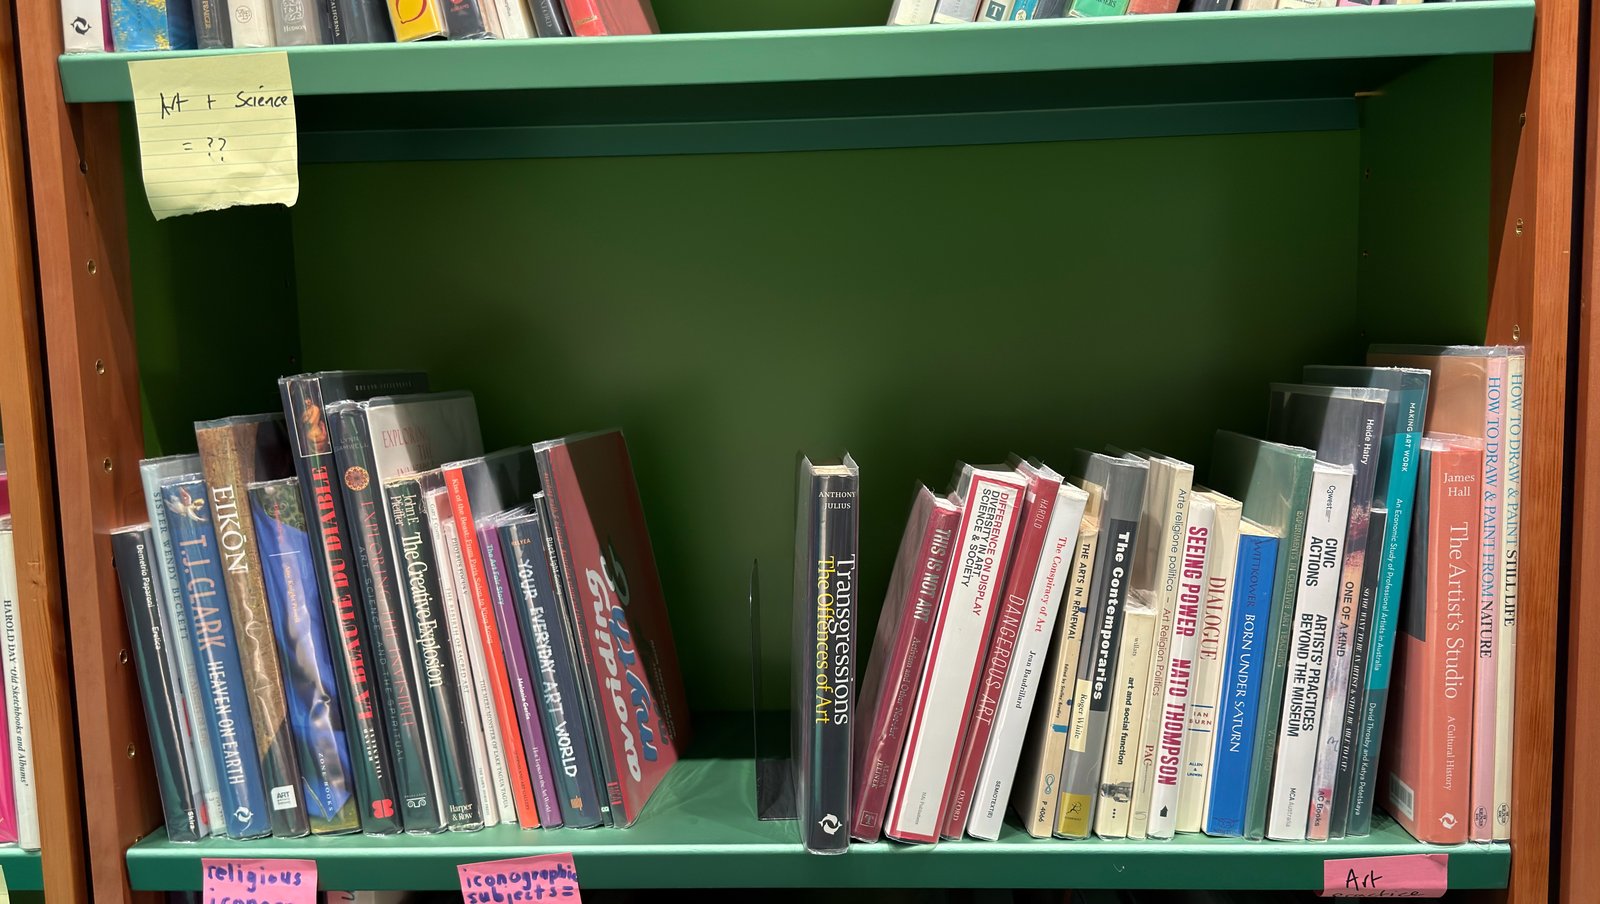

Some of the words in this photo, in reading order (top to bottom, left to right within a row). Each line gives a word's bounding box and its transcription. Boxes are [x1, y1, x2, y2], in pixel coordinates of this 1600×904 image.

[160, 93, 189, 120] Art
[207, 95, 217, 110] +
[235, 85, 288, 108] Science
[182, 142, 192, 151] =
[207, 137, 227, 162] ??
[1487, 376, 1500, 413] HOW
[1510, 373, 1522, 411] HOW
[1362, 418, 1376, 442] Heide
[1405, 402, 1416, 432] MAKING
[1486, 417, 1498, 438] TO
[1509, 415, 1521, 435] TO
[1359, 442, 1372, 464] Hatry
[1404, 434, 1412, 447] ART
[1400, 449, 1410, 472] WORK
[1485, 442, 1498, 486] DRAW
[1507, 439, 1520, 484] DRAW
[1444, 472, 1475, 484] James
[1448, 486, 1470, 496] Hall
[1507, 487, 1518, 499] &
[310, 465, 342, 551] DIABLE
[824, 502, 851, 510] JULIUS
[973, 487, 991, 533] SCIENCE
[1176, 488, 1187, 509] Arte
[1395, 498, 1402, 508] An
[1484, 490, 1496, 502] &
[980, 489, 1000, 542] DIVERSITY
[986, 492, 1009, 556] DIFFERENCE
[1033, 498, 1048, 529] HAROLD
[1391, 509, 1401, 541] Economic
[1483, 505, 1496, 550] PAINT
[1505, 502, 1518, 547] PAINT
[401, 530, 424, 560] The
[929, 525, 952, 556] THIS
[971, 533, 980, 541] &
[1055, 535, 1067, 554] The
[1114, 530, 1129, 562] The
[1168, 510, 1184, 552] religione
[1448, 520, 1469, 559] The
[179, 534, 211, 574] T.J.
[358, 545, 368, 568] ART
[925, 556, 943, 572] IS
[977, 543, 987, 555] IN
[1080, 542, 1090, 558] THE
[1181, 525, 1210, 580] SEEING
[1306, 536, 1324, 587] ACTIONS
[1323, 538, 1338, 568] CIVIC
[1387, 543, 1397, 562] Study
[153, 491, 168, 534] SISTER
[162, 539, 177, 580] WENDY
[171, 587, 189, 641] BECKETT
[328, 554, 349, 588] DU
[516, 558, 538, 600] YOUR
[817, 555, 835, 589] The
[960, 543, 978, 587] SOCIETY
[981, 556, 993, 574] ON
[1040, 554, 1061, 605] Conspiracy
[1076, 562, 1086, 583] ARTS
[1163, 555, 1178, 591] politica
[1246, 538, 1262, 607] WITTKOWER
[1481, 552, 1494, 597] FROM
[1504, 549, 1517, 592] STILL
[406, 560, 436, 620] Creative
[444, 587, 452, 600] THE
[919, 571, 940, 597] NOT
[971, 573, 989, 615] DISPLAY
[1074, 586, 1082, 596] IN
[1342, 580, 1355, 603] ONE
[1381, 571, 1393, 611] Professional
[1445, 562, 1467, 631] Artist's
[186, 575, 225, 652] CLARK
[364, 577, 380, 630] SCIENCE
[912, 597, 933, 623] ART
[1039, 606, 1048, 615] of
[1161, 607, 1172, 622] Art
[1174, 582, 1202, 637] POWER
[1198, 575, 1227, 661] DIALOGUE
[1340, 605, 1351, 620] OF
[1503, 594, 1516, 626] LIFE
[447, 604, 458, 635] REBIRTH
[815, 592, 835, 669] Offences
[1034, 616, 1045, 633] Art
[1067, 599, 1080, 640] RENEWAL
[1091, 565, 1124, 700] Contemporaries
[1241, 613, 1255, 650] BORN
[1298, 612, 1313, 658] BEYOND
[1339, 622, 1348, 631] A
[1378, 612, 1387, 634] Artists
[1479, 599, 1493, 657] NATURE
[376, 640, 386, 665] AND
[414, 618, 447, 688] Explosion
[453, 637, 461, 647] OF
[528, 605, 556, 675] EVERYDAY
[831, 553, 856, 726] Transgressions
[988, 594, 1024, 689] DANGEROUS
[1154, 624, 1170, 662] Religion
[1310, 613, 1328, 665] ARTISTS'
[1335, 632, 1348, 657] KIND
[1377, 634, 1384, 642] in
[456, 649, 466, 678] SACRED
[1026, 649, 1035, 667] Jean
[1373, 642, 1383, 670] Australia
[1442, 637, 1465, 699] Studio
[382, 672, 391, 692] THE
[461, 679, 469, 693] ART
[816, 673, 832, 692] of
[1152, 664, 1164, 696] Politics
[1167, 657, 1193, 698] NATO
[1235, 652, 1251, 697] UNDER
[1294, 660, 1308, 684] THE
[206, 660, 232, 717] HEAVEN
[541, 679, 563, 716] ART
[1015, 668, 1031, 709] Baudrillard
[1077, 693, 1087, 714] Roger
[1125, 690, 1133, 705] and
[1302, 669, 1322, 731] PRACTICES
[354, 689, 373, 720] LA
[815, 695, 831, 723] Art
[976, 696, 996, 726] ART
[1121, 707, 1131, 730] social
[1287, 686, 1303, 737] MUSEUM
[217, 717, 236, 737] ON
[386, 698, 404, 762] SPIRITUAL
[1073, 716, 1083, 739] White
[1189, 718, 1212, 726] BURN
[1228, 700, 1245, 752] SATURN
[553, 720, 578, 779] WORLD
[1117, 732, 1128, 765] function
[1143, 744, 1154, 766] PAC
[1155, 699, 1186, 785] THOMPSON
[1446, 724, 1455, 757] Cultural
[221, 740, 245, 785] EARTH
[1443, 759, 1454, 790] History
[450, 803, 472, 812] Harper
[952, 789, 965, 821] OXFORD
[1316, 790, 1325, 802] AC
[1037, 806, 1046, 822] 4066
[1313, 803, 1324, 826] Books
[208, 863, 302, 892] religious
[1346, 868, 1382, 890] Art
